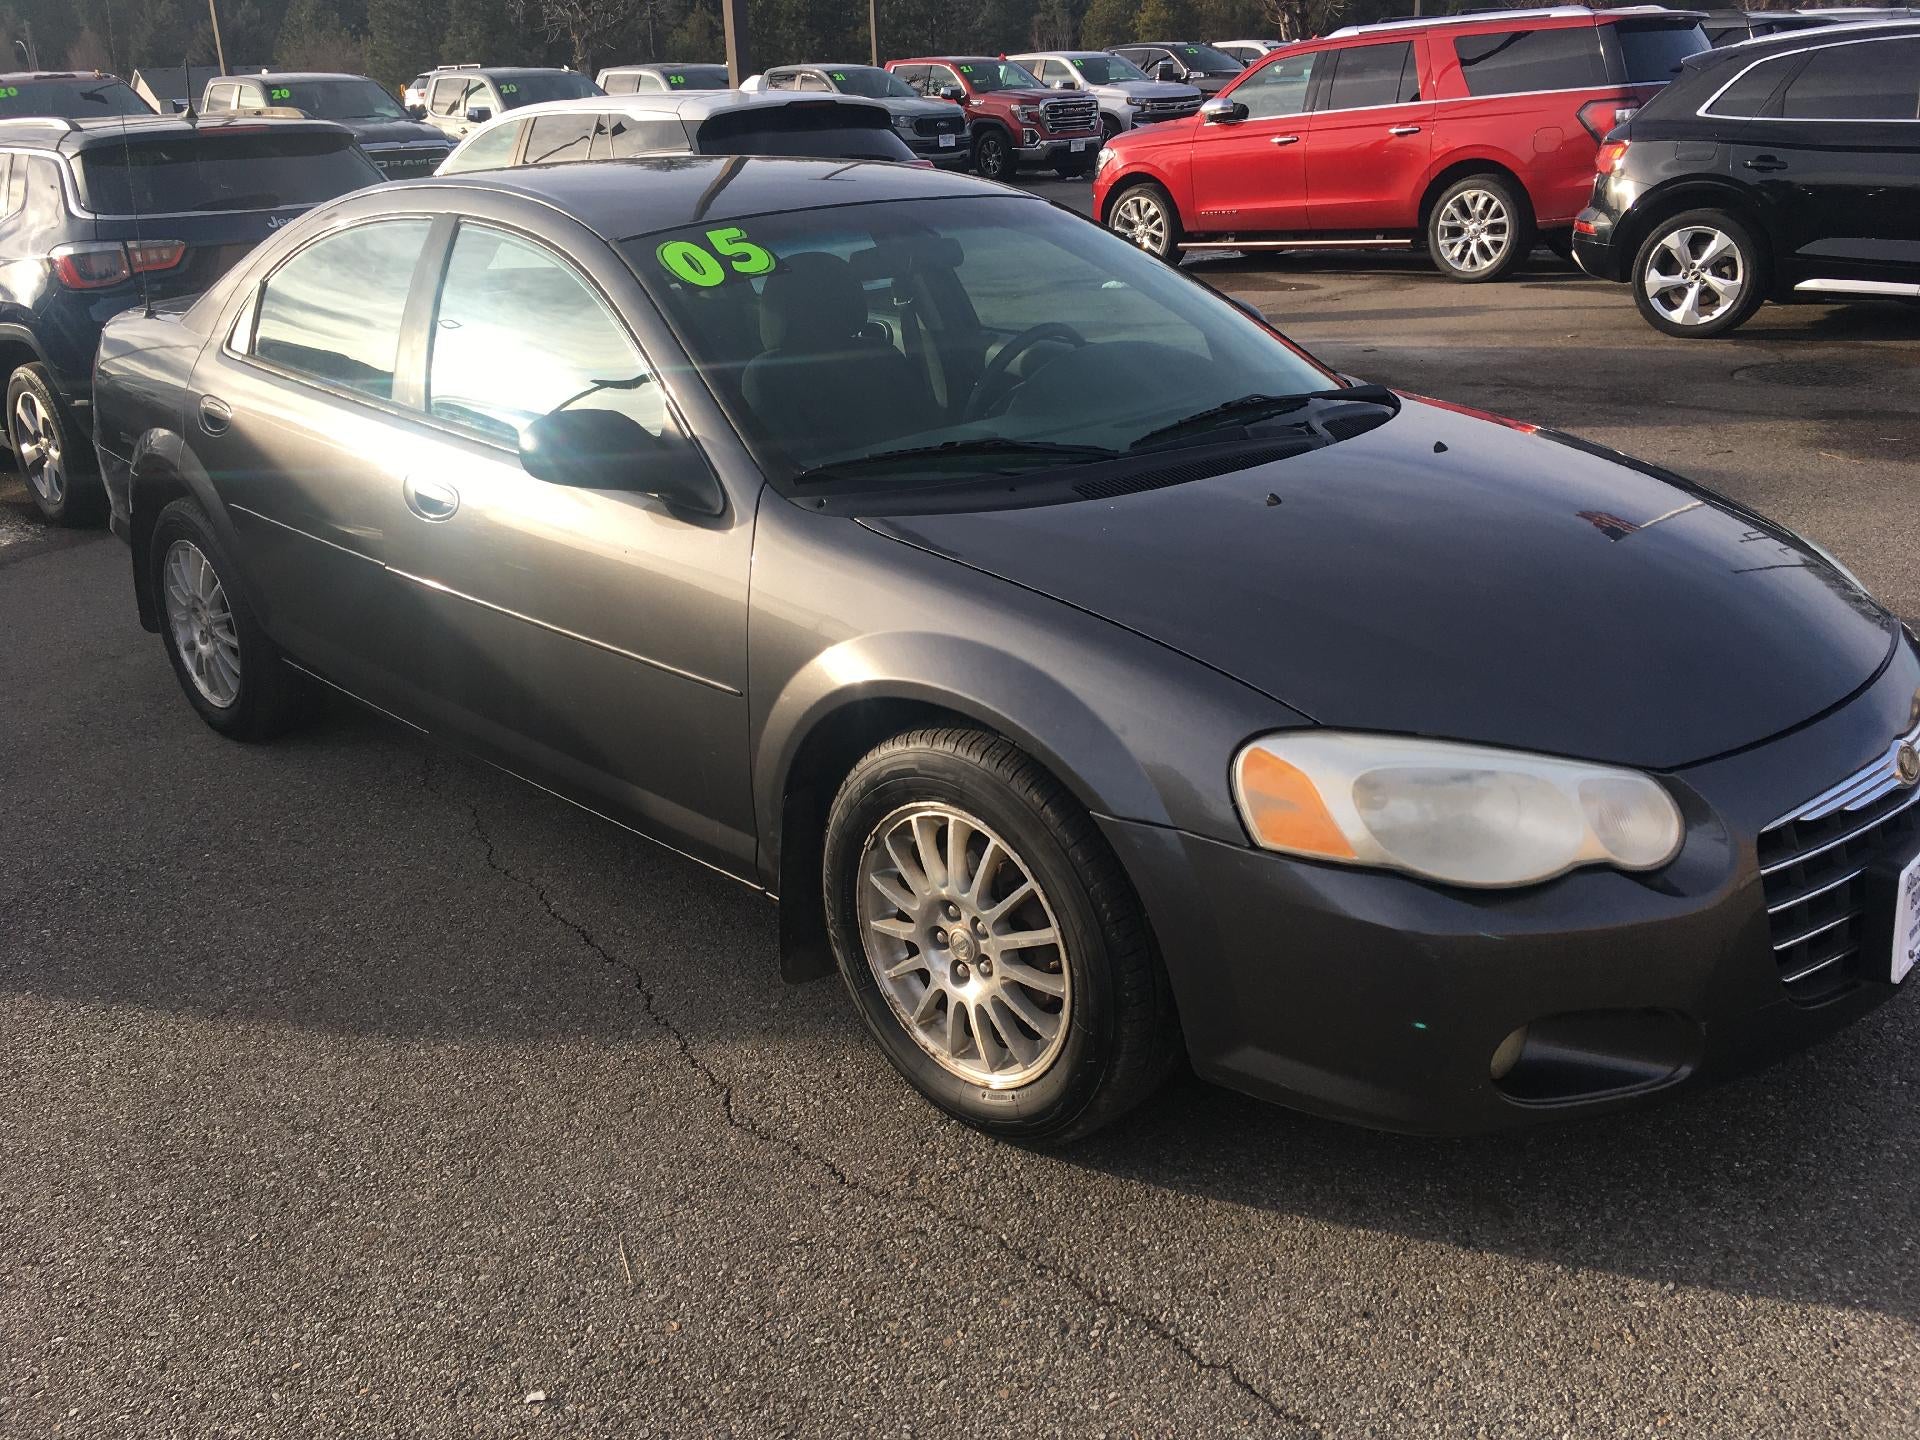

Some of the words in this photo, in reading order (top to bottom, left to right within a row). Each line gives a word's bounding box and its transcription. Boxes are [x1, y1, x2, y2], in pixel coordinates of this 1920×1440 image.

[960, 65, 973, 73] 21
[670, 75, 685, 84] 20
[833, 73, 846, 81] 21
[500, 84, 517, 93] 20
[271, 89, 290, 100] 20
[266, 215, 295, 229] Je
[656, 227, 776, 288] 05
